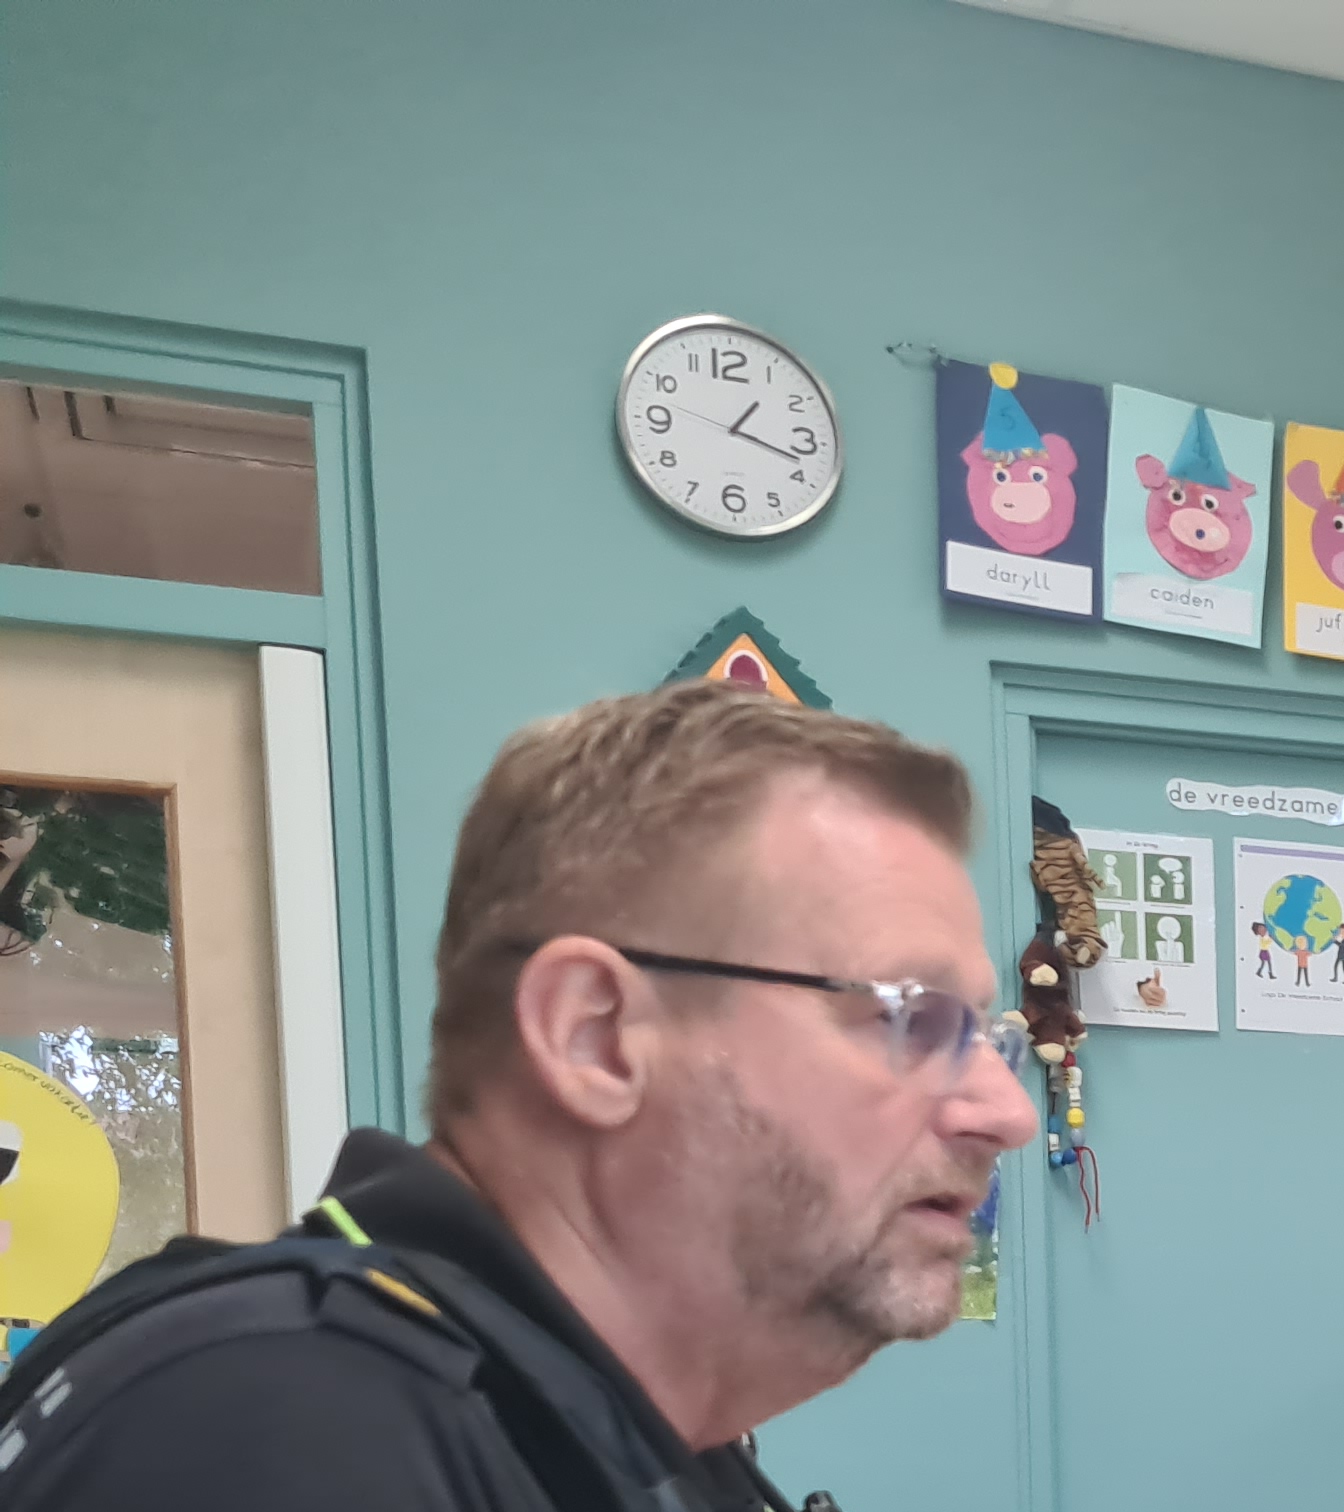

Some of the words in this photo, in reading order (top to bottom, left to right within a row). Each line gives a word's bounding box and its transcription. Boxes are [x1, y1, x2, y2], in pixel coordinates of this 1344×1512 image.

[688, 354, 699, 373] 11
[711, 348, 749, 384] 12
[656, 373, 677, 393] 10
[766, 365, 771, 384] 1
[788, 395, 805, 413] 2
[646, 405, 672, 434] 9
[791, 427, 818, 455] 3
[659, 451, 677, 468] 8
[789, 470, 806, 483] 4
[687, 481, 699, 499] 7
[721, 484, 747, 513] 6
[766, 492, 781, 508] 5
[985, 564, 1051, 592] daryll
[1150, 587, 1215, 609] caiden
[1316, 613, 1342, 633] juf
[1169, 782, 1197, 803] de
[1206, 791, 1338, 816] vreedzame
